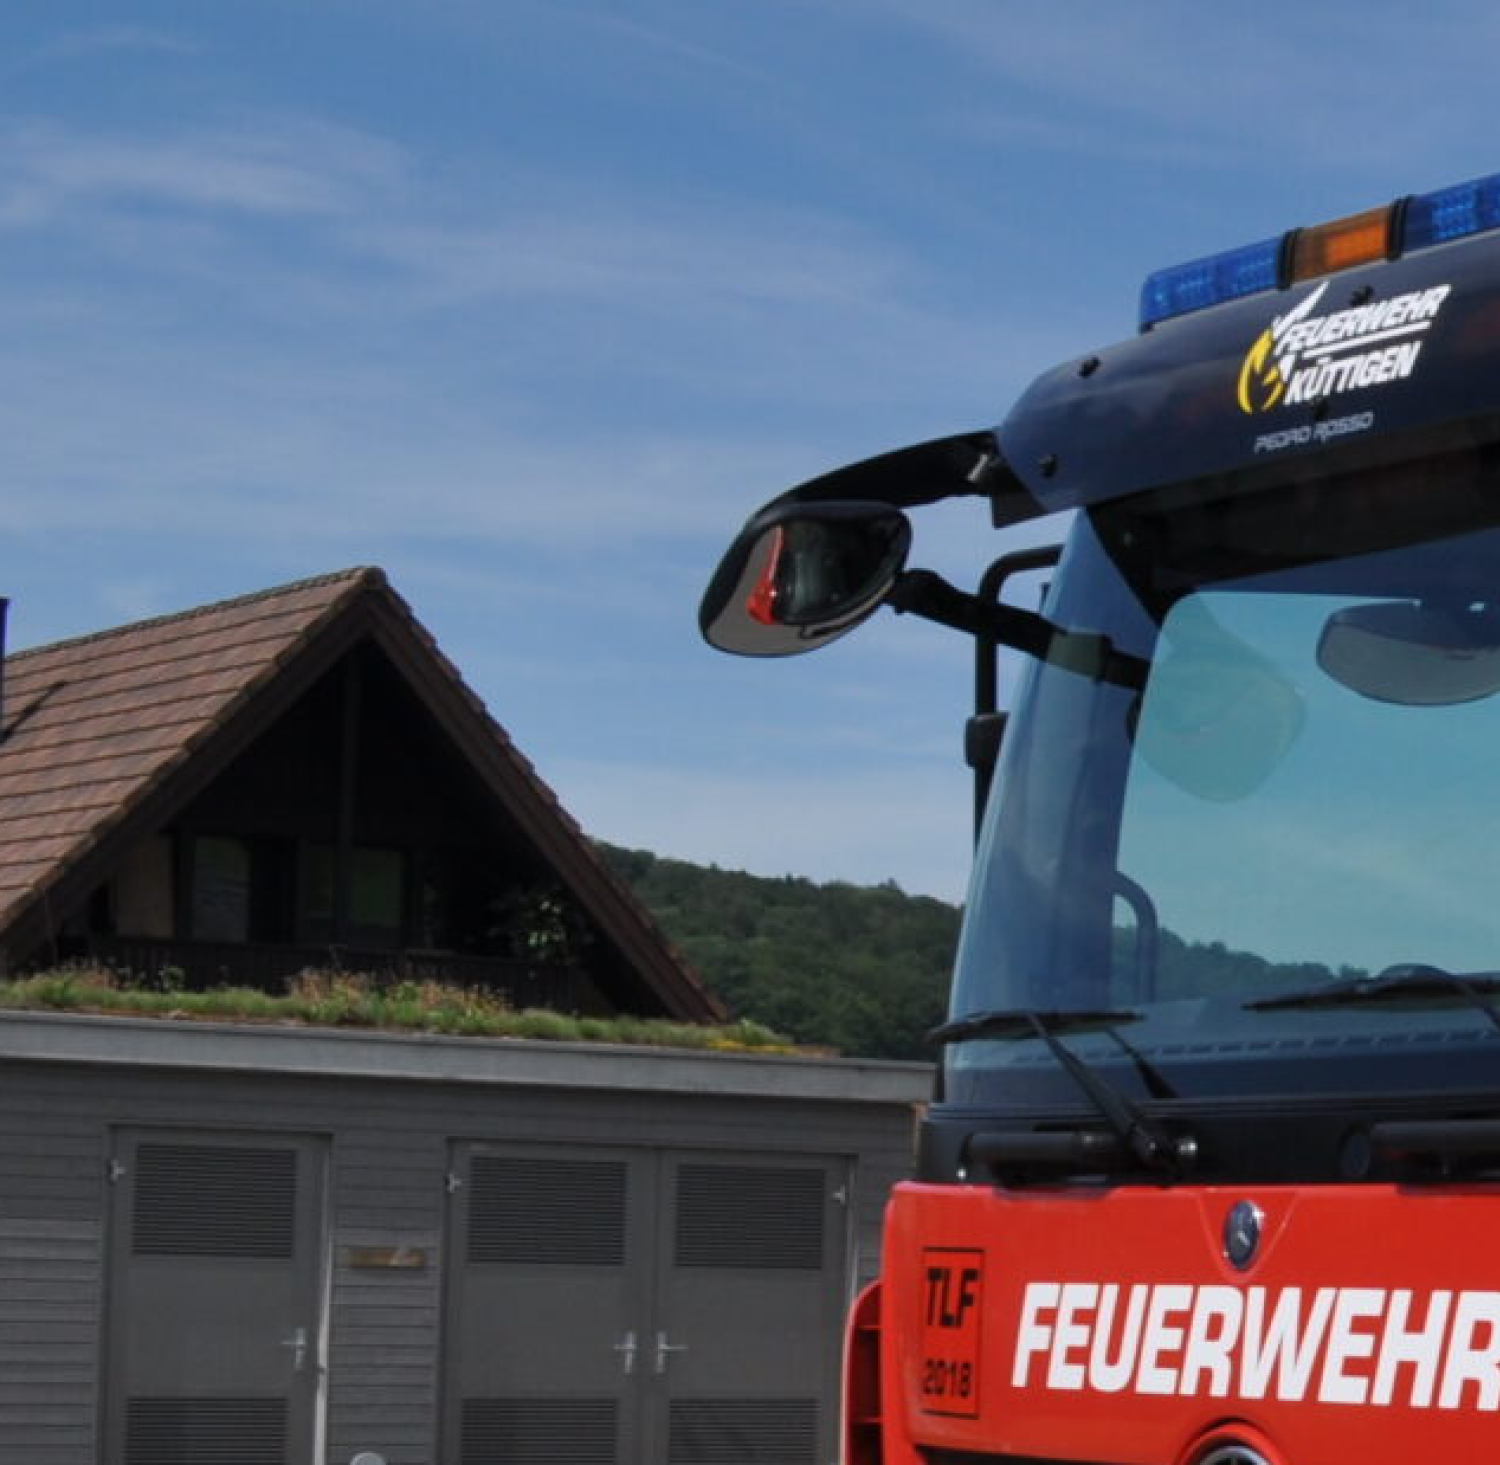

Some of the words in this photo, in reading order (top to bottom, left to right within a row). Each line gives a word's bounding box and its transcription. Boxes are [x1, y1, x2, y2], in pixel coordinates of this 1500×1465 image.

[1275, 284, 1452, 355] FEUERWEHR
[926, 1267, 980, 1328] TLF
[922, 1358, 971, 1399] 2018
